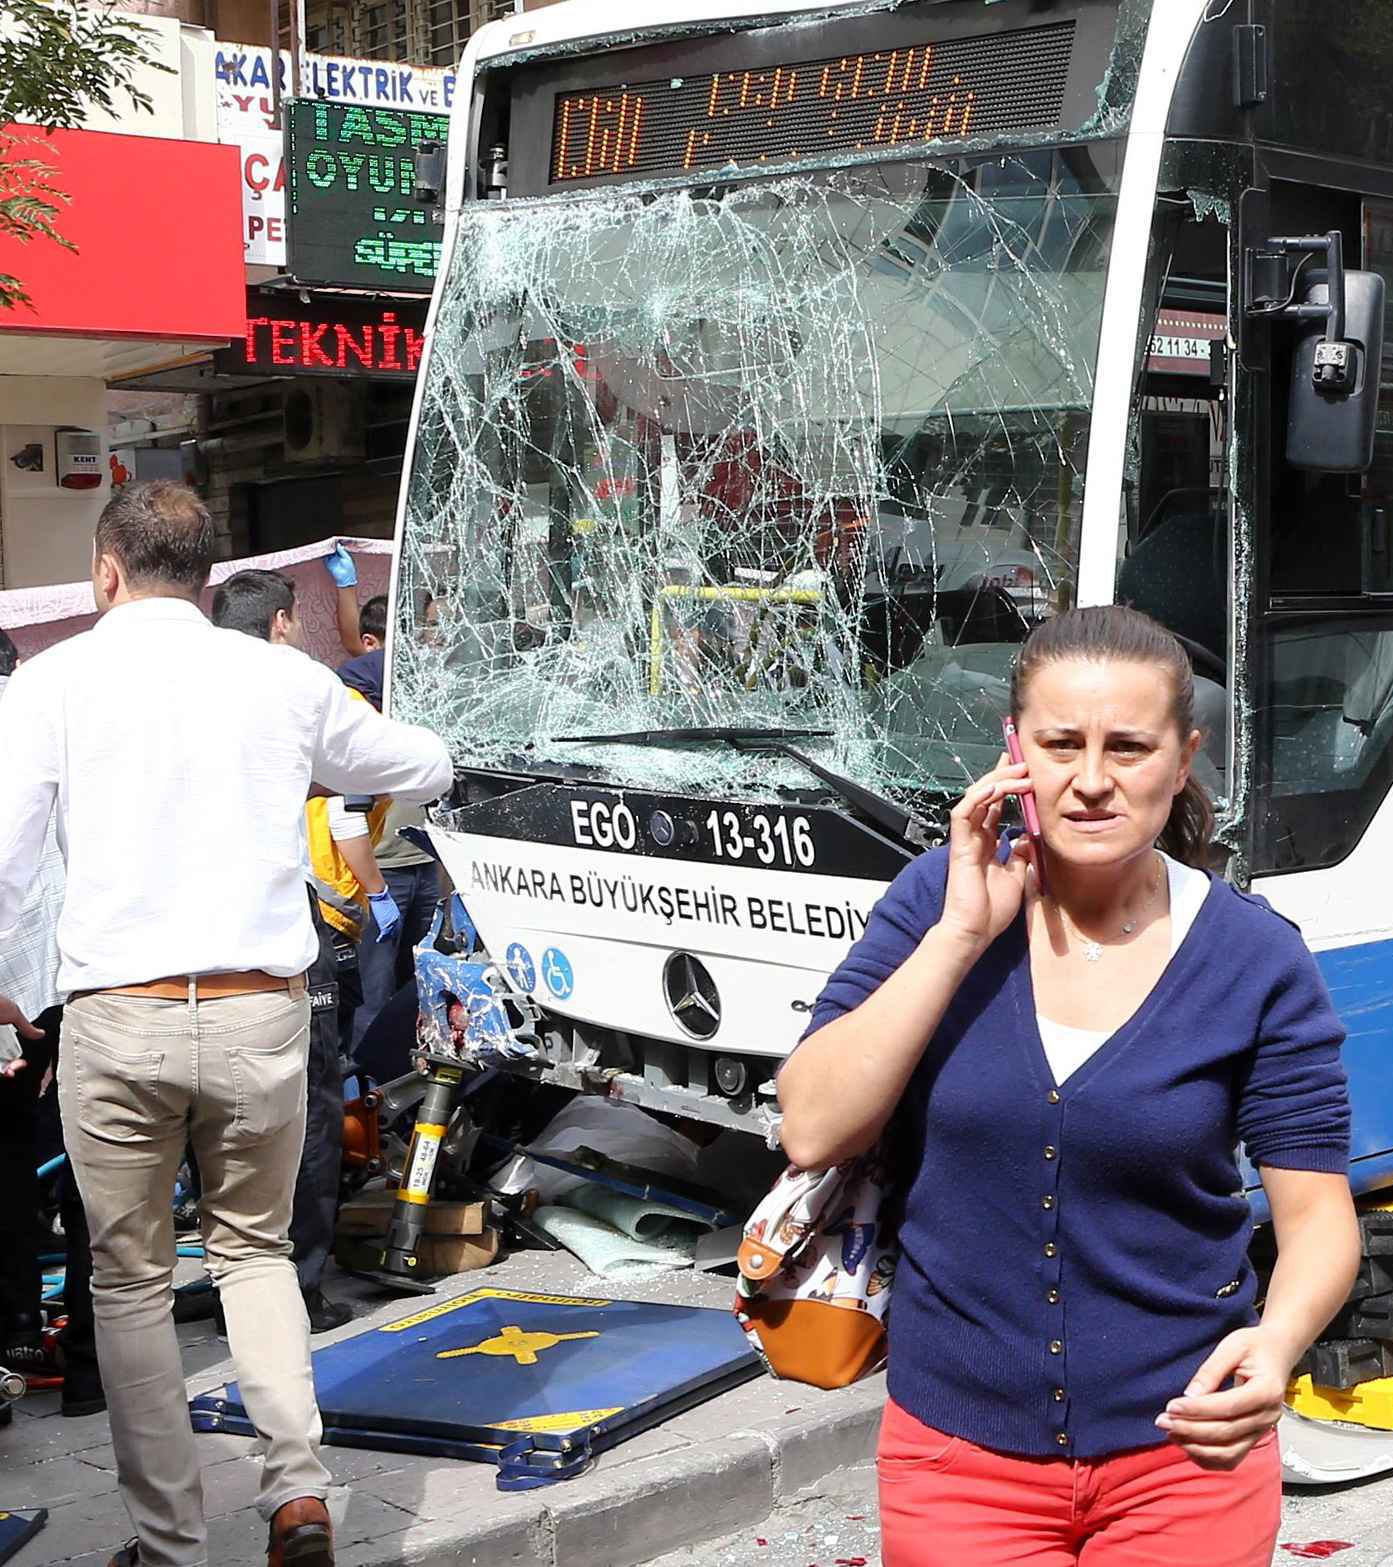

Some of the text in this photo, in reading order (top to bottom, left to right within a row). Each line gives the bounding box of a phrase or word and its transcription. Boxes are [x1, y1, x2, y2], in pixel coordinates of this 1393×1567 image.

[419, 90, 438, 107] VE
[248, 216, 284, 242] PE
[246, 312, 426, 371] TEKNİK
[1184, 339, 1198, 356] 34
[571, 799, 815, 867] EGO 13-316
[471, 861, 872, 941] ANKARA BÜYÜKŞEHİR BELEDİY
[309, 991, 333, 1007] FAİYE
